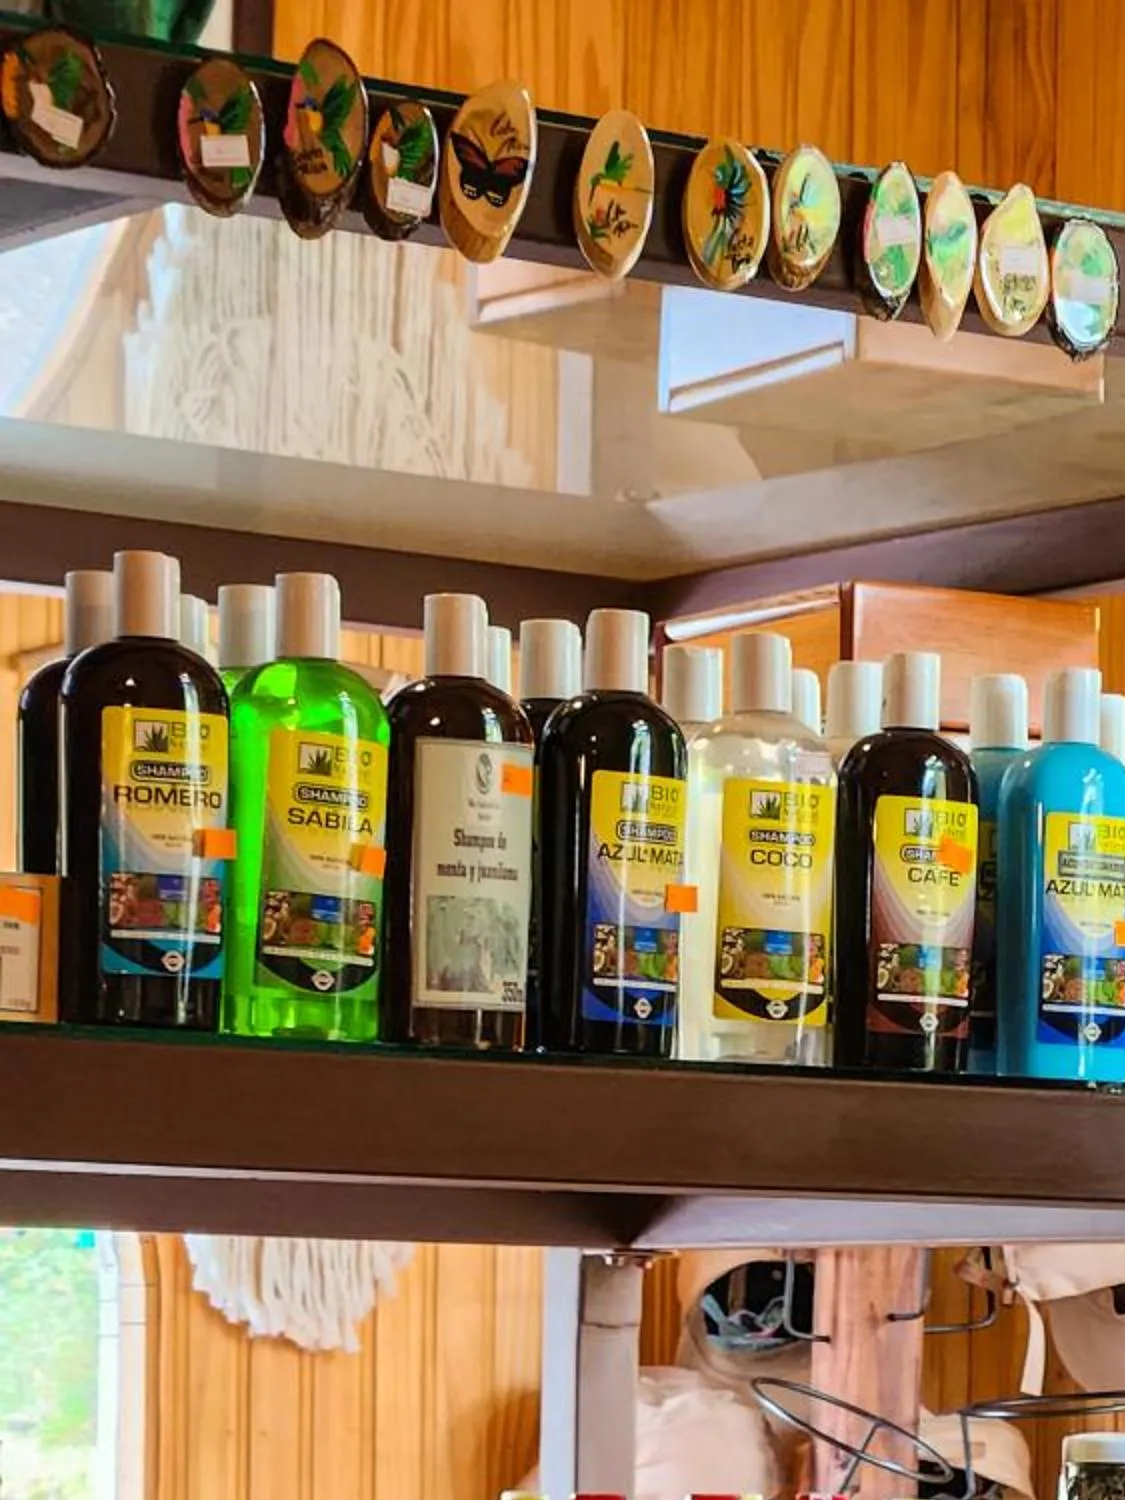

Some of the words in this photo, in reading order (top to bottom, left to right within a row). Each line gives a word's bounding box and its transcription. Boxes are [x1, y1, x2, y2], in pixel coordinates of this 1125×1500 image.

[171, 720, 211, 740] BO
[335, 745, 372, 767] BO
[136, 761, 208, 780] SHAMPO
[113, 784, 222, 809] ROMERO
[299, 785, 368, 809] SHAMPO
[651, 784, 679, 803] BIO
[287, 806, 374, 837] SABILA
[750, 848, 813, 869] COCO
[1045, 878, 1093, 898] AZUL
